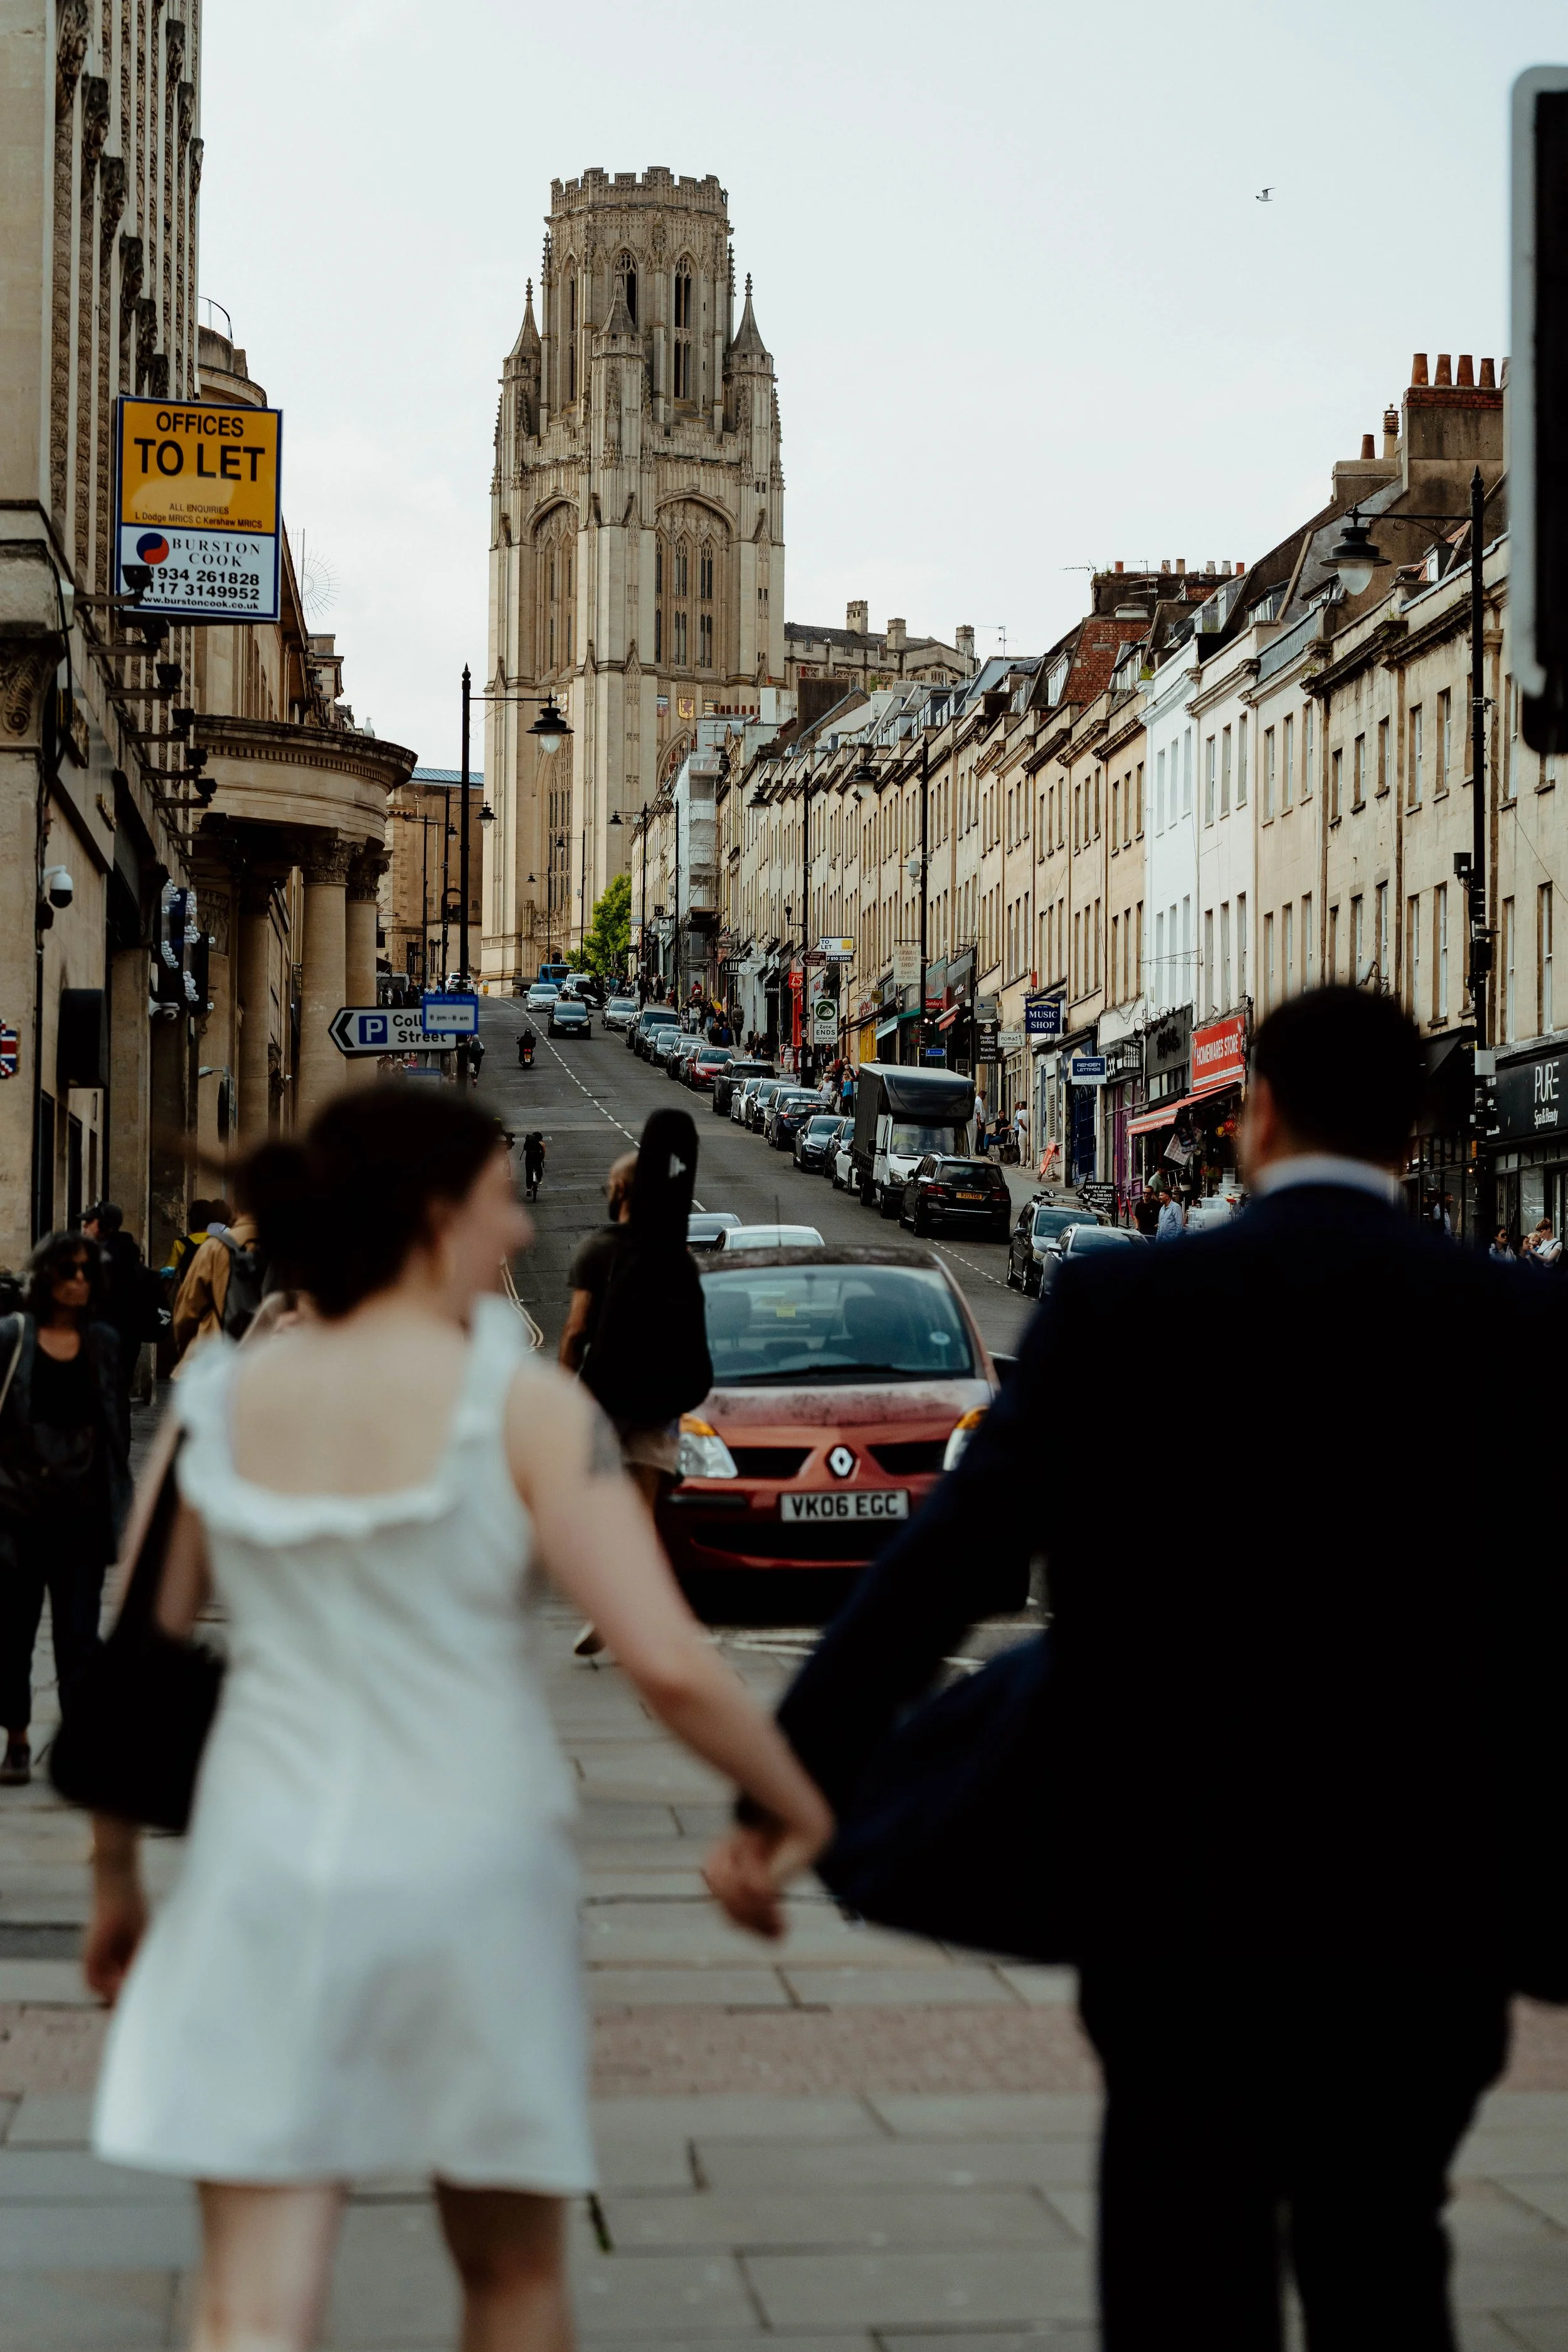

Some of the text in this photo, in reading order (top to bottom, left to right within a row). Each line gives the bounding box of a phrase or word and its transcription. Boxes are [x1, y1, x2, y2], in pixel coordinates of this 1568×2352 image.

[156, 411, 244, 438] OFFICES
[134, 438, 266, 482] TO LET
[169, 503, 229, 515] ALL ENQUIRIES
[135, 512, 262, 528] L Dodge MRICS C Kershaw MRICS
[172, 537, 260, 555] BURSTON
[189, 552, 243, 568] COOK
[196, 570, 260, 586] 261828
[185, 584, 260, 600] 3149952
[790, 975, 803, 985] £5
[366, 1019, 383, 1041] P
[397, 1030, 447, 1043] Street
[1197, 1039, 1224, 1066] HOMEWARES
[1224, 1033, 1239, 1056] STORE
[1534, 1061, 1559, 1104] PURE
[1534, 1110, 1542, 1129] Spa
[1545, 1108, 1559, 1126] Beauty
[792, 1494, 898, 1517] VK06 EGC
